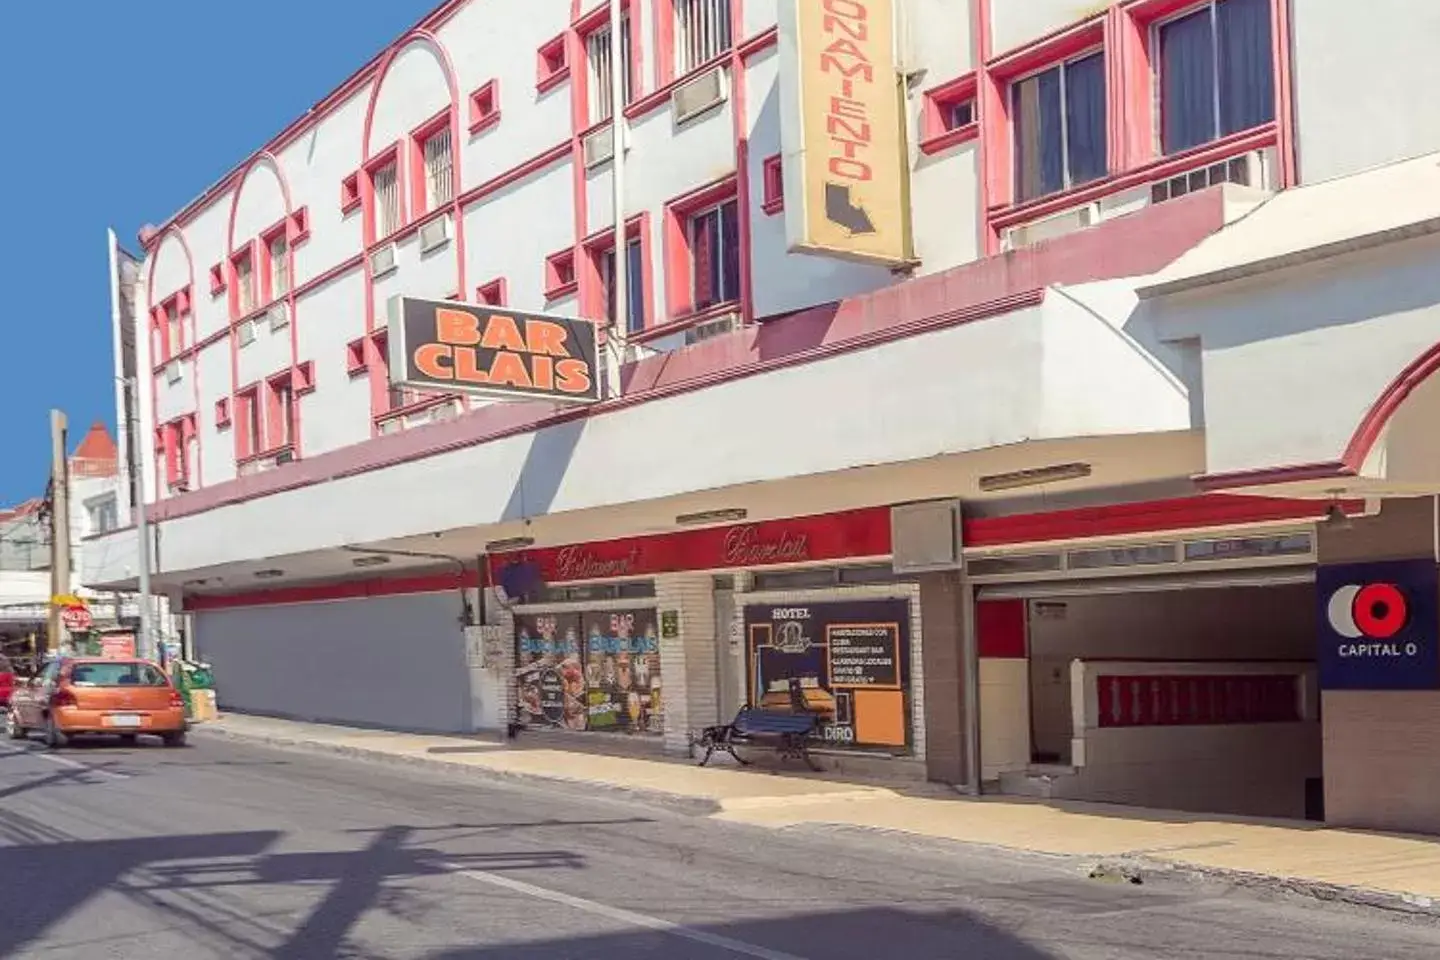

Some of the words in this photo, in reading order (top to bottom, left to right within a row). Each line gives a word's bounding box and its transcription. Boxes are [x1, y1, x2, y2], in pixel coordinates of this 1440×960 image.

[435, 307, 571, 357] BAR
[413, 343, 591, 393] CLAIS
[772, 607, 811, 620] HOTEL
[1338, 643, 1401, 657] CAPITAL
[1405, 642, 1417, 656] O
